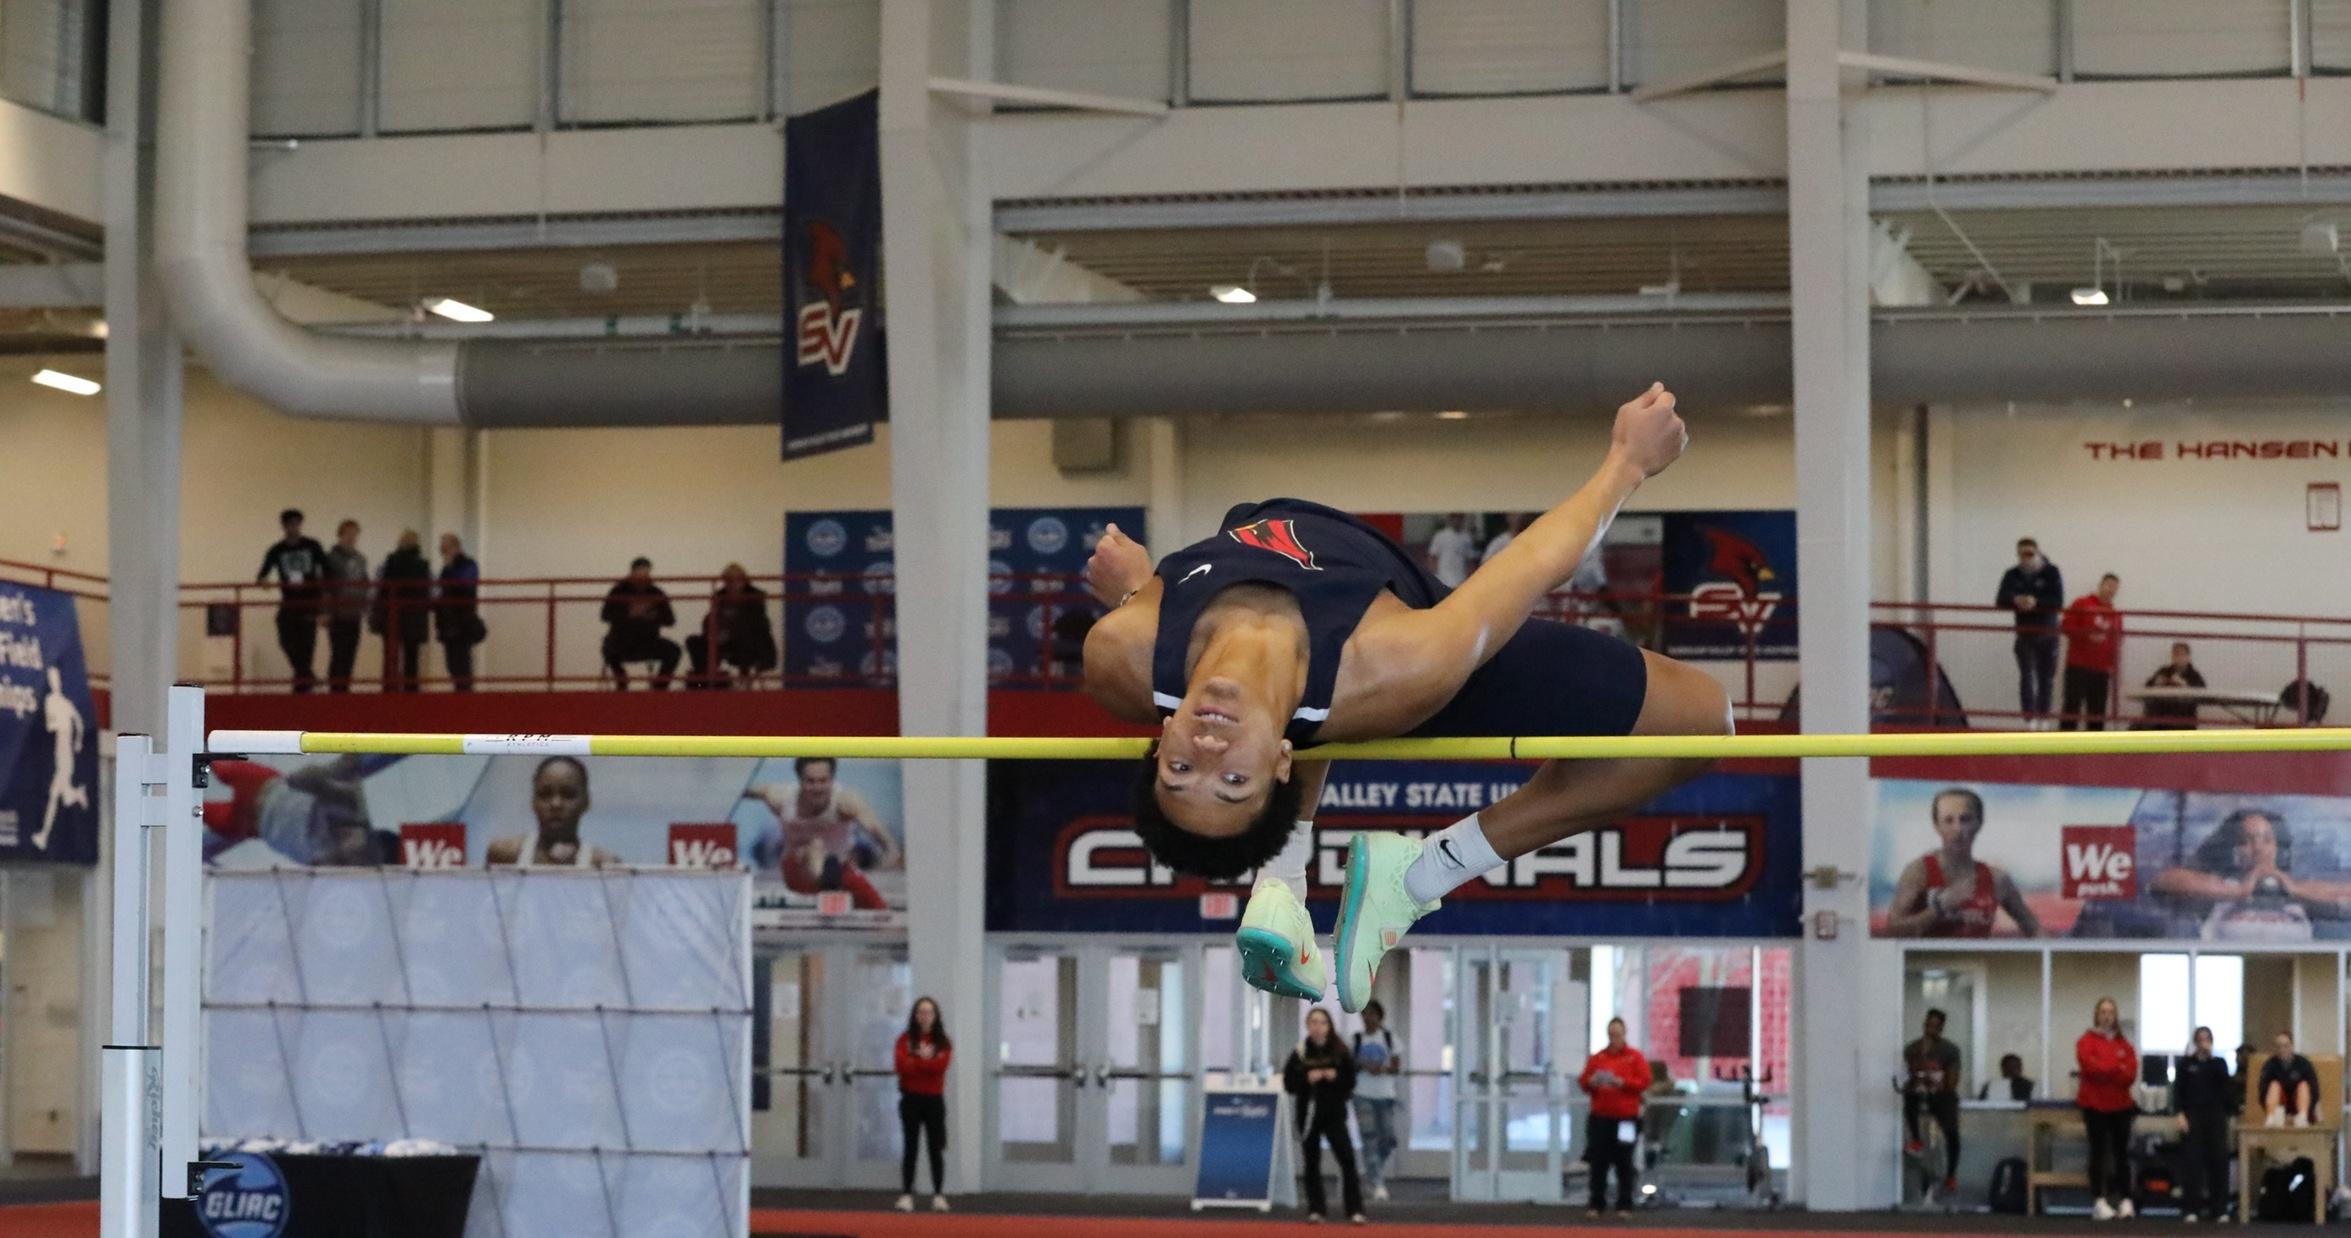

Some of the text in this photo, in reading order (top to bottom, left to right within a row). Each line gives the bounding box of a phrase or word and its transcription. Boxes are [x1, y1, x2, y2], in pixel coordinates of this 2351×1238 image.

[2084, 442, 2163, 460] THE
[2177, 441, 2338, 459] HANSEN
[1320, 783, 1398, 808] ALLEY
[1406, 783, 1482, 807] STATE
[403, 839, 464, 869] We
[672, 839, 737, 869] We
[2066, 843, 2132, 881] We
[204, 1191, 283, 1221] GLIAC
